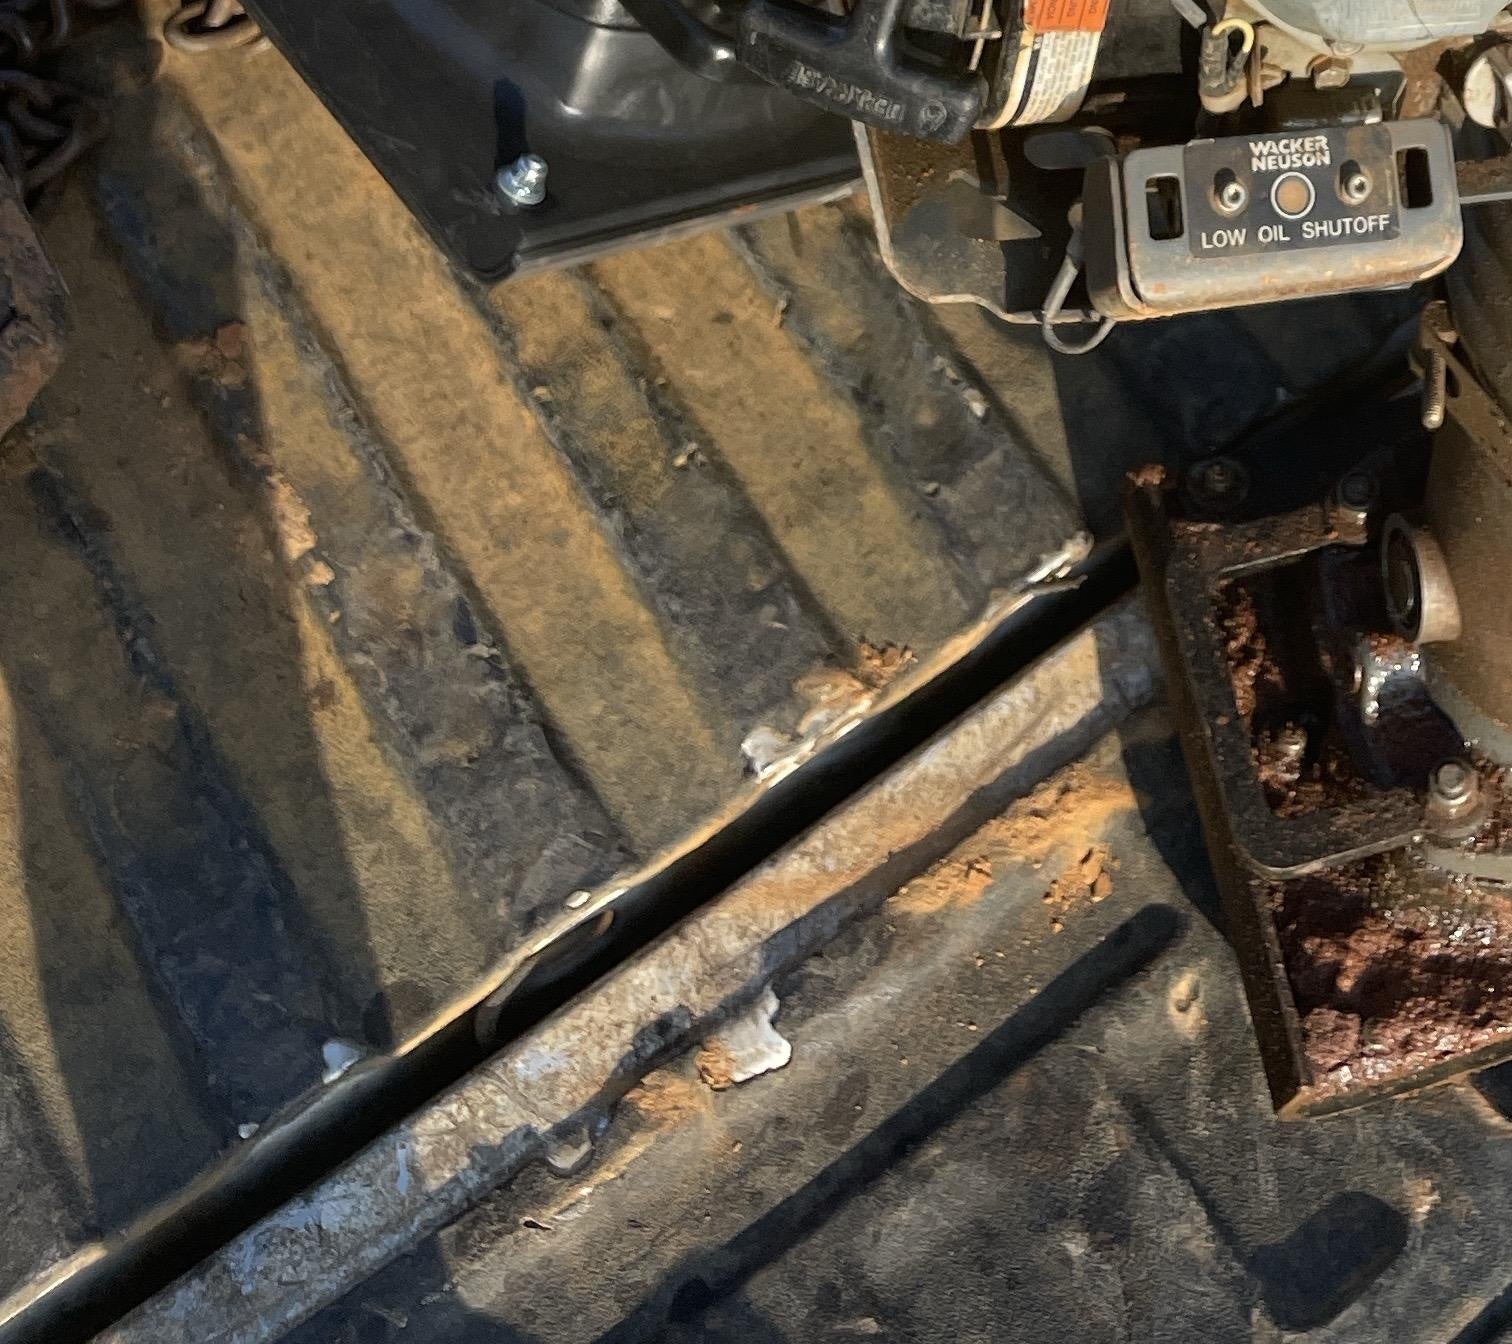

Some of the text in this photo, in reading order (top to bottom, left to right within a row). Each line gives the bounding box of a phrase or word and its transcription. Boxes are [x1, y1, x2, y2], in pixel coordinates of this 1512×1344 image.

[1248, 135, 1330, 157] WACKER
[1250, 150, 1332, 173] NEUSON
[1201, 213, 1391, 250] LOW OIL SHUTOFF
